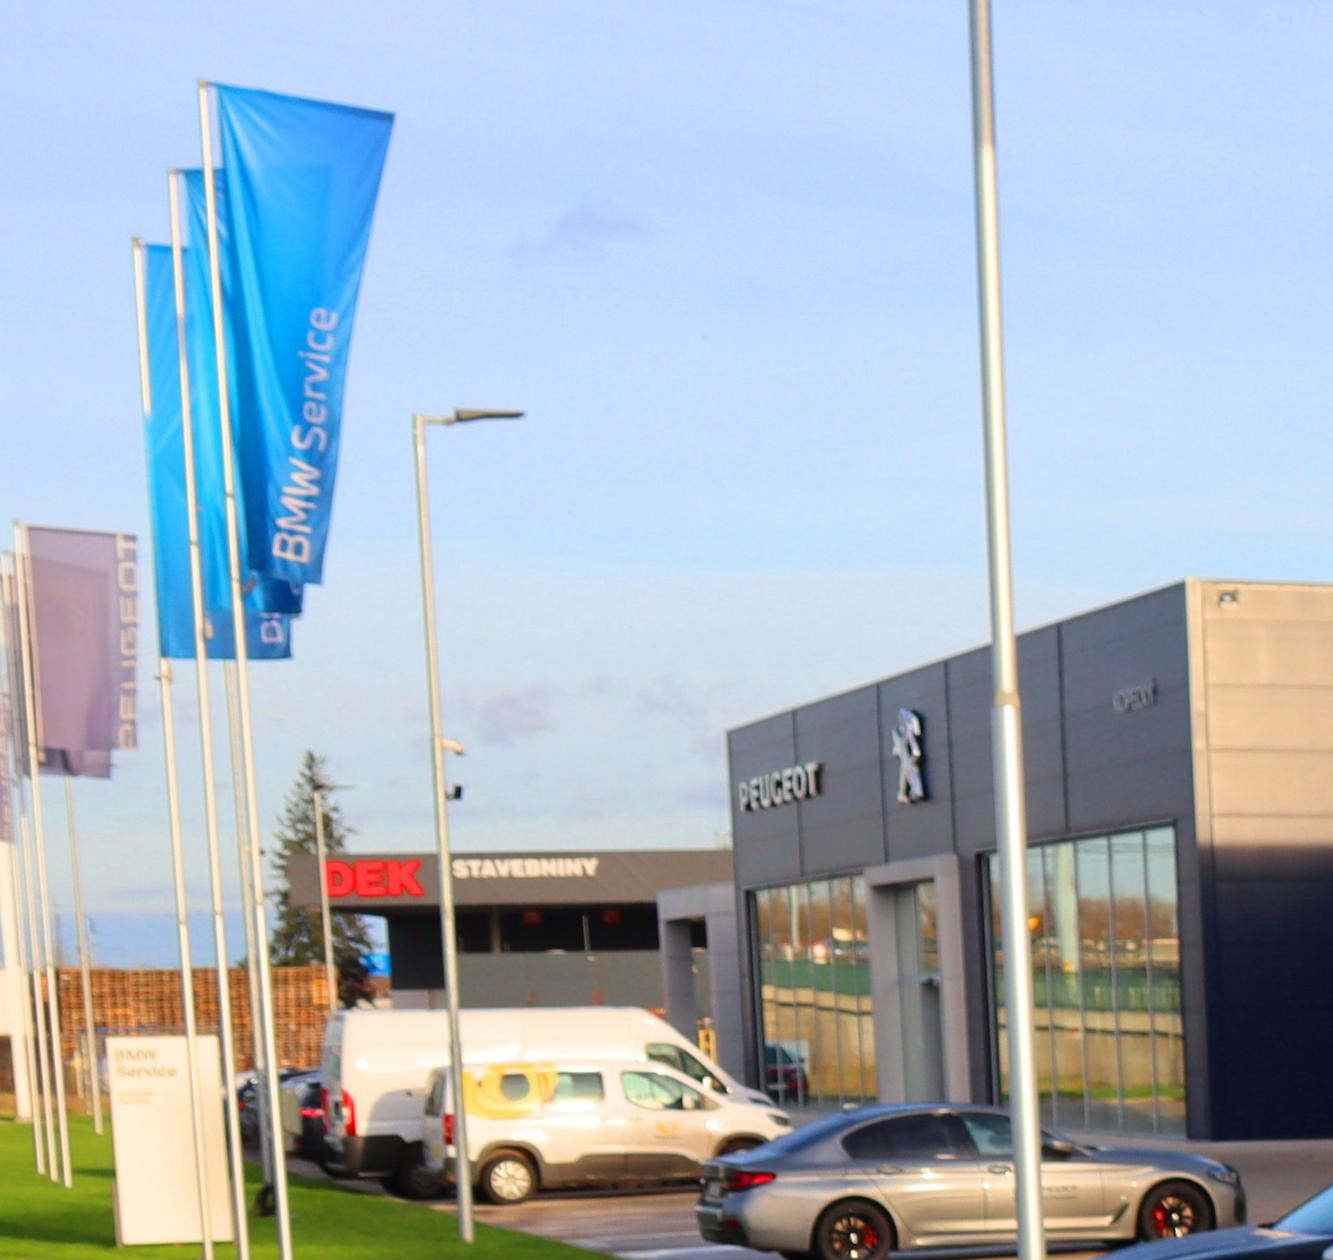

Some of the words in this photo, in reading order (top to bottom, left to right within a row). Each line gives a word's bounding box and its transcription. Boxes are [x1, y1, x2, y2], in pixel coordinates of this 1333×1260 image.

[290, 307, 339, 453] Service
[272, 456, 321, 565] BMW
[739, 762, 819, 812] PEUGEOT
[326, 859, 425, 897] DEK
[452, 857, 599, 879] STAVEBNINY
[117, 1066, 177, 1078] Service
